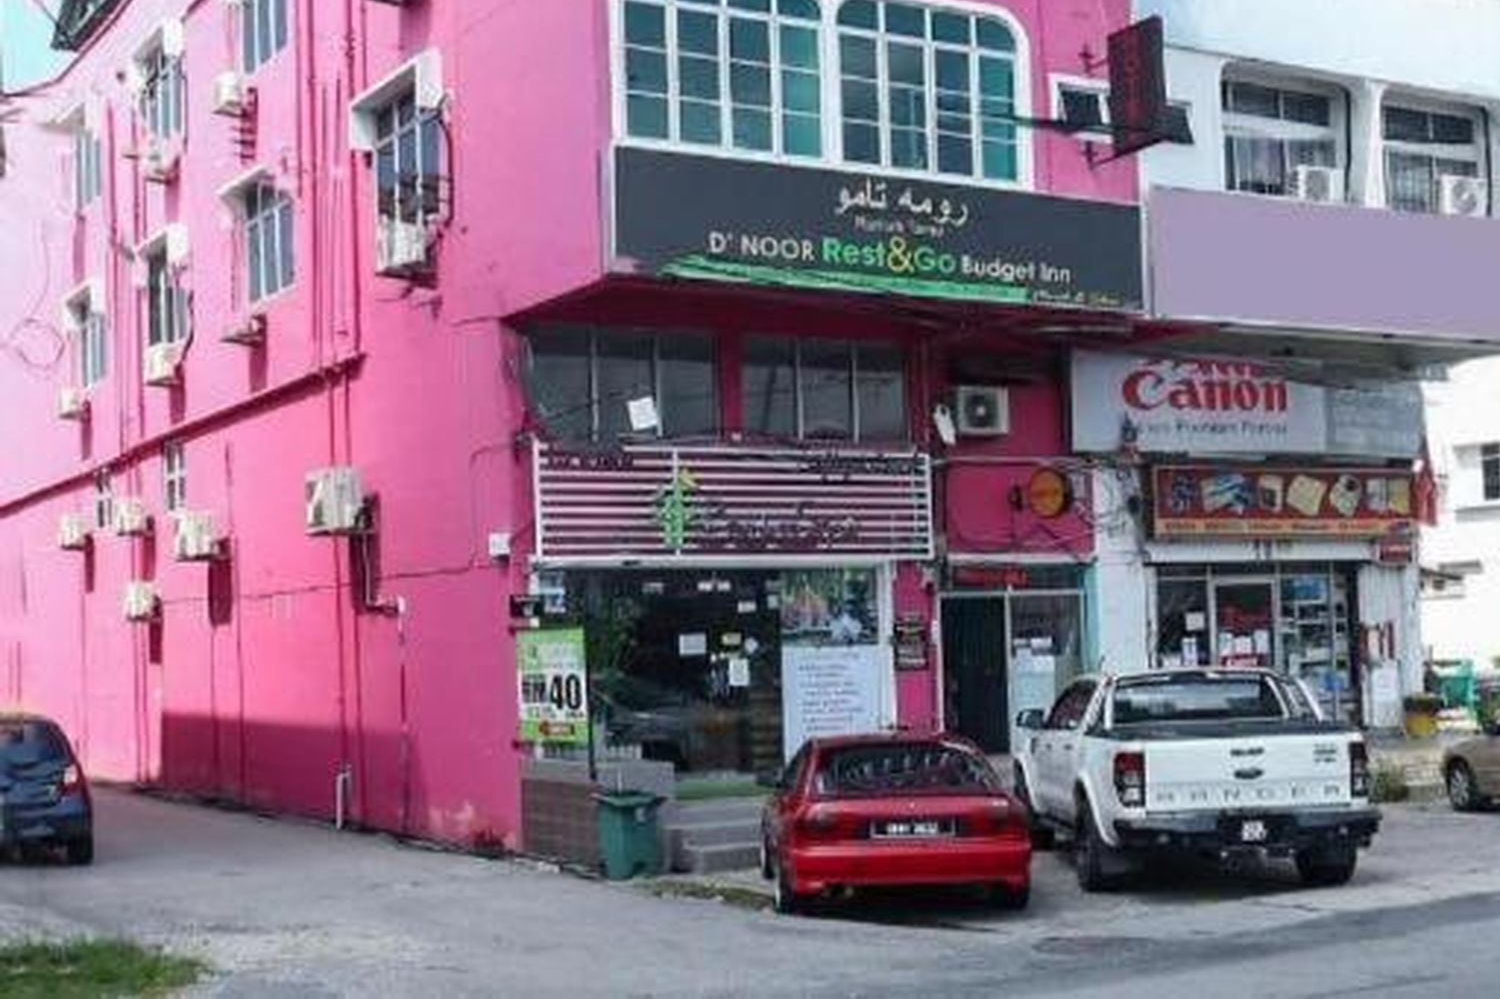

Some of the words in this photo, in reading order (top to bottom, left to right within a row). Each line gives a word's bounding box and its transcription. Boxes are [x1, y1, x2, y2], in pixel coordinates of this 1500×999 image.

[740, 234, 815, 262] NOOR
[960, 254, 1036, 283] Budget
[1039, 262, 1071, 284] Inn
[1122, 369, 1287, 412] Canon
[551, 673, 582, 711] 40
